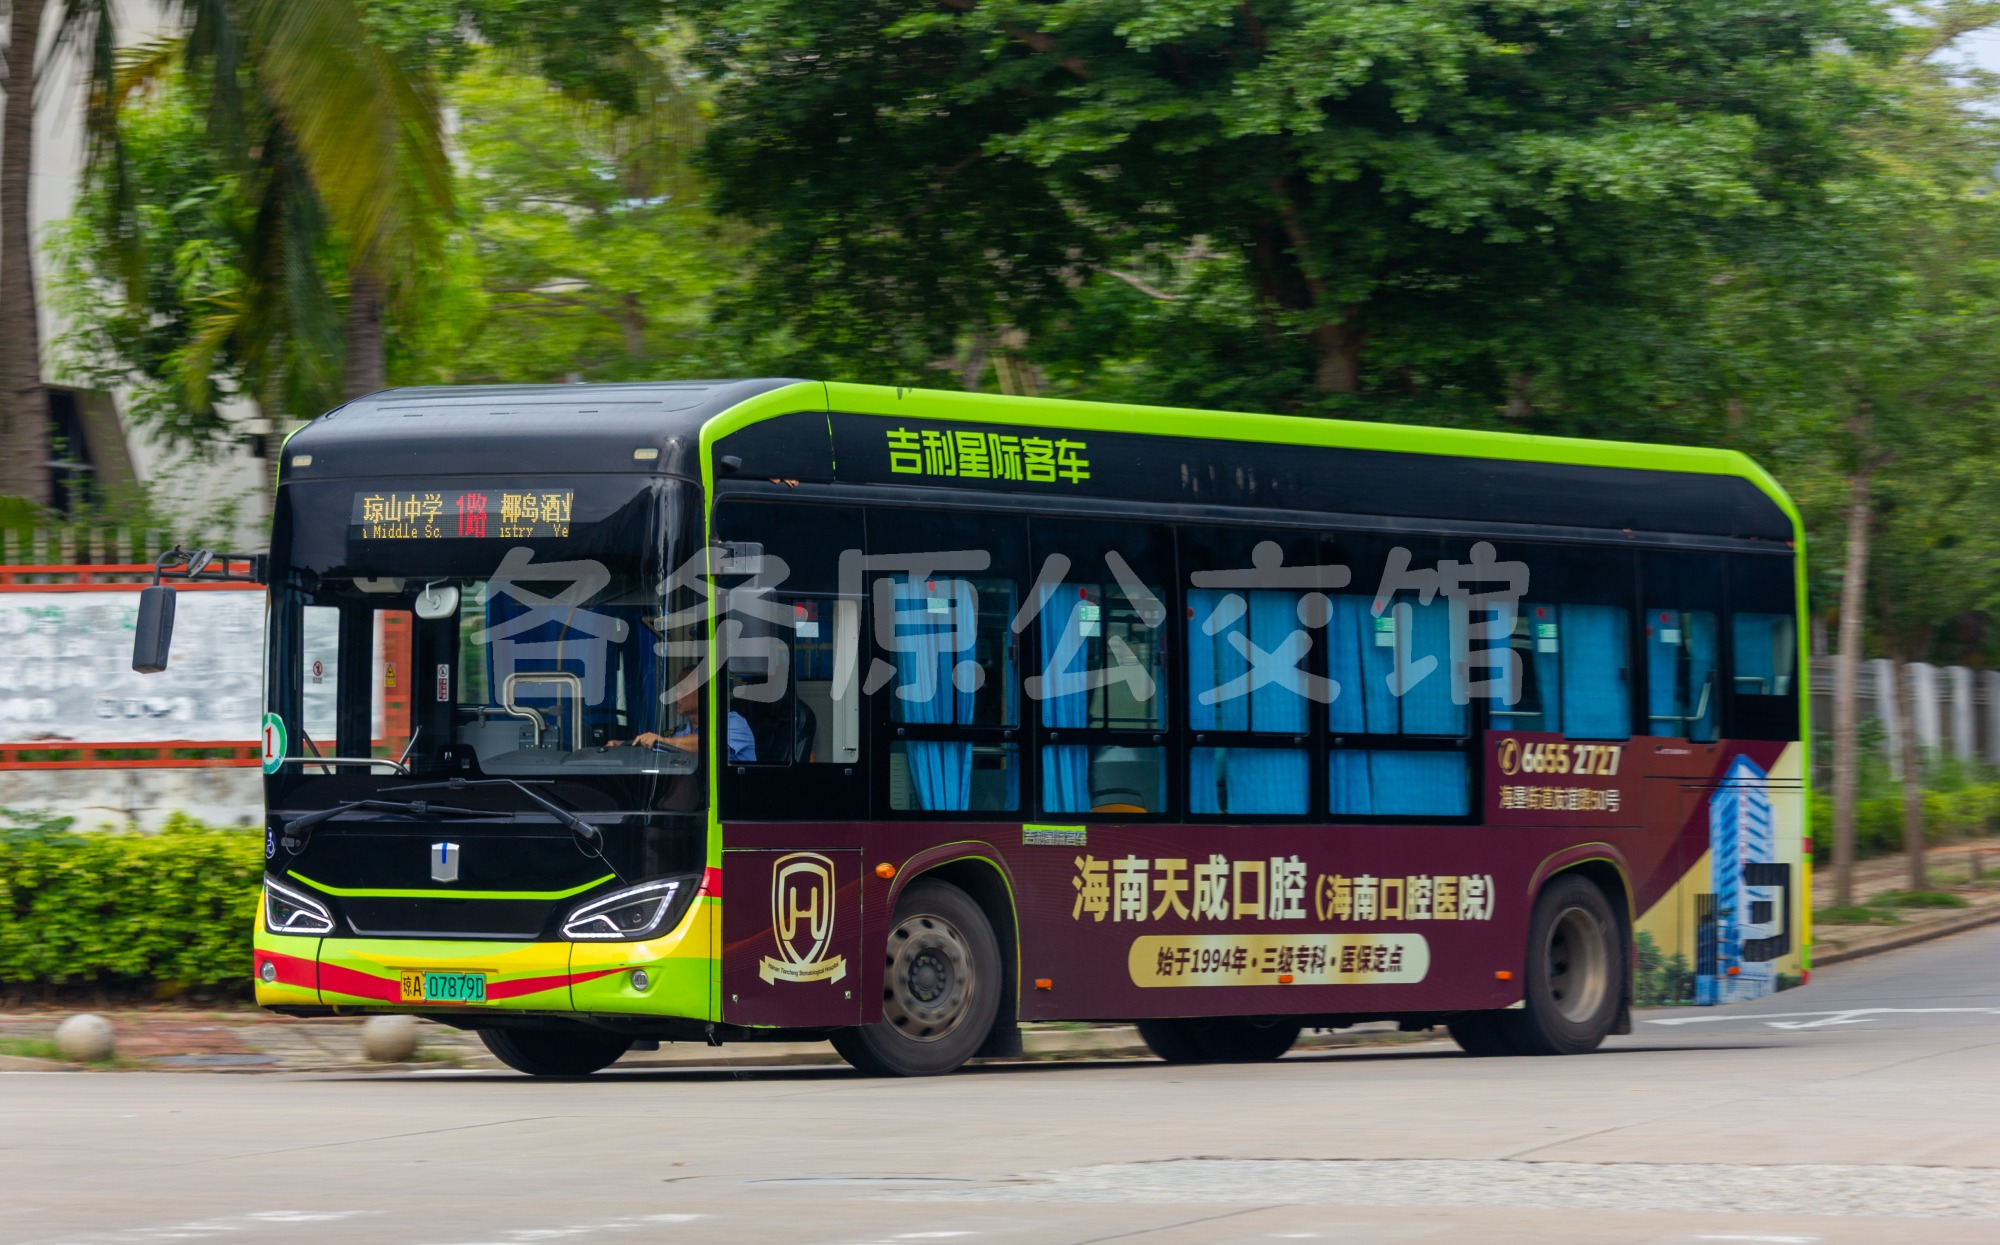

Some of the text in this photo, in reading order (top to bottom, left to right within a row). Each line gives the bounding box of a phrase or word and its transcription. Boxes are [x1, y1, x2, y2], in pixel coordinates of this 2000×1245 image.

[886, 427, 1091, 484] 吉利星际客车
[363, 493, 443, 524] 琼山中学
[373, 523, 418, 539] Middle
[265, 727, 273, 758] 1
[1521, 743, 1622, 775] 6655 2727
[1072, 854, 1307, 922] 海南天成口腔
